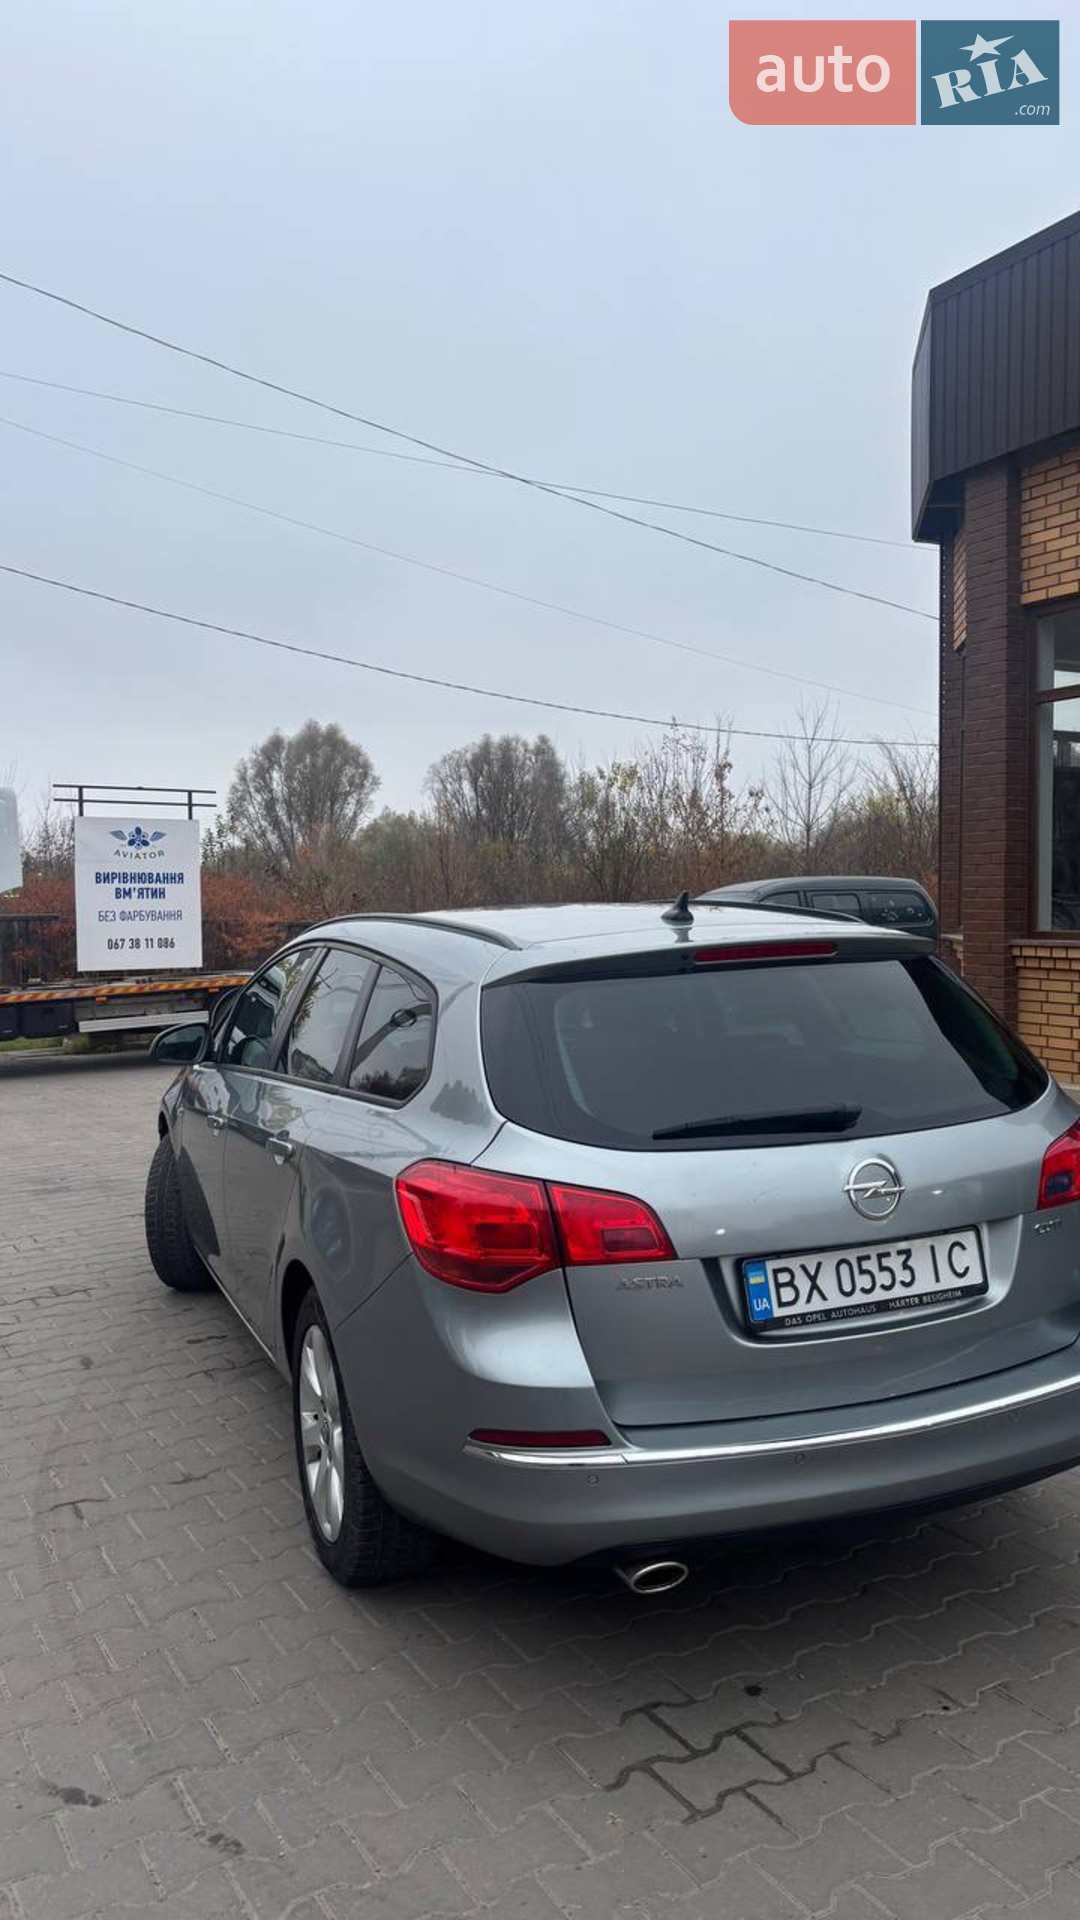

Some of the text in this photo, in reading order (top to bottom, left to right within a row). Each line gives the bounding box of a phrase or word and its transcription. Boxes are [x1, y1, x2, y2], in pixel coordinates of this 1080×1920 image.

[114, 849, 165, 860] AVIATOR
[95, 872, 184, 885] ВИРІВНЮВАННЯ
[114, 887, 166, 900] ВМ'ЯТИН
[98, 909, 183, 922] БЕЗ ФАРБУВАННЯ
[107, 937, 175, 950] 067 38 11 086
[616, 1274, 684, 1291] ASTRA
[772, 1261, 829, 1309] BX
[835, 1248, 916, 1298] 0553
[753, 1299, 771, 1312] UA
[785, 1315, 803, 1327] DAS
[805, 1312, 827, 1324] OPEL
[831, 1304, 877, 1319] AUTOHAUS
[922, 1290, 962, 1305] BESIGHEIM
